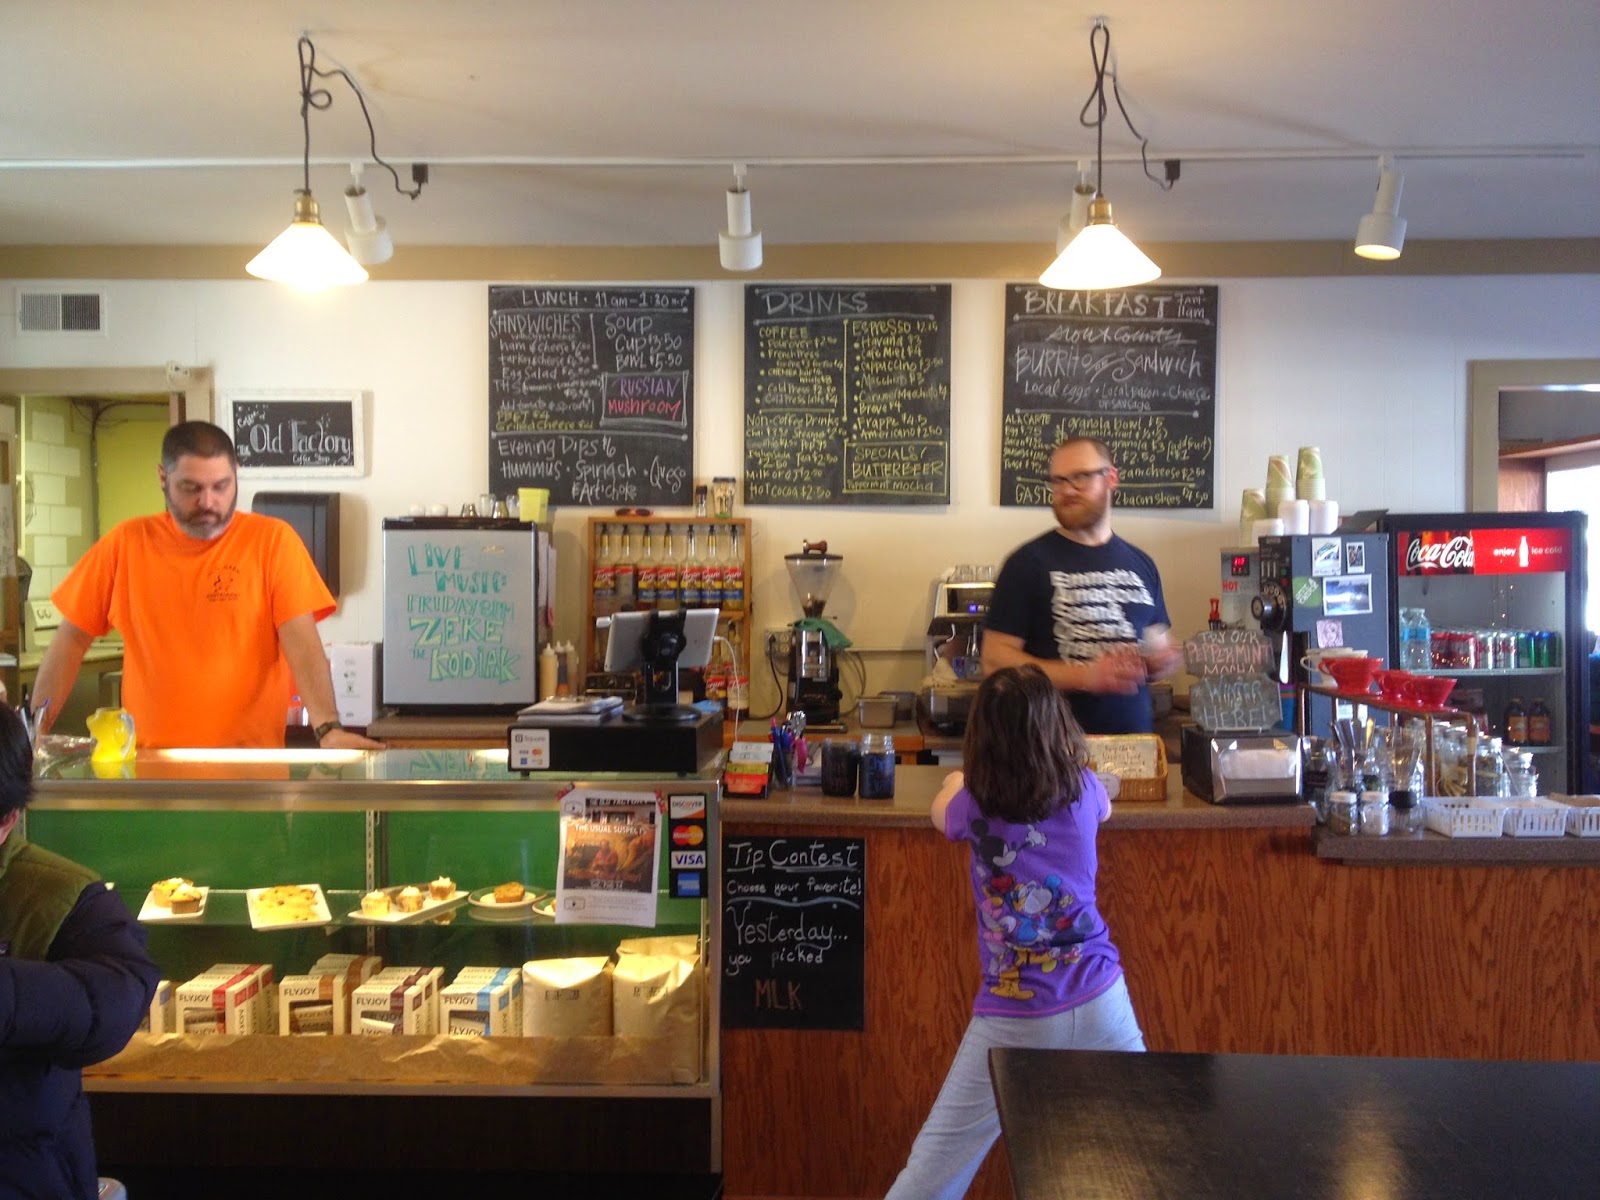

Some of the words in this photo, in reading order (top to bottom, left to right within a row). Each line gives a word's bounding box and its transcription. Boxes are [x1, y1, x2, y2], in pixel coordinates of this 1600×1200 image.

[522, 290, 579, 308] LUNCH
[762, 291, 869, 316] DRINKS
[1024, 289, 1173, 319] BREAKFAST
[490, 312, 581, 339] SANDWICHES
[605, 312, 653, 340] SOUP
[759, 326, 808, 340] COFFEE
[499, 339, 526, 351] ham
[861, 335, 904, 349] Havana
[524, 365, 558, 380] Salad
[1112, 348, 1202, 384] Sandwich
[619, 377, 681, 399] RUSSIAN
[1025, 379, 1061, 397] Local
[1101, 382, 1129, 398] Local
[1068, 417, 1111, 434] granola
[1114, 416, 1142, 431] bowl
[249, 422, 285, 455] Old
[288, 417, 352, 464] Factory
[498, 438, 556, 461] Evening
[1111, 439, 1148, 456] granola
[575, 453, 637, 481] Spinach
[852, 460, 944, 480] BUTTERBEER
[579, 478, 637, 506] Artichoke
[1406, 536, 1475, 572] Coca-Cola
[1492, 547, 1517, 558] enjoy
[1531, 545, 1543, 556] ice
[1544, 545, 1564, 556] cold
[1222, 580, 1239, 592] HOT
[407, 593, 480, 616] FRIDAY
[409, 616, 507, 648] ZEKE
[1230, 630, 1260, 645] OUR
[429, 646, 521, 684] KODIAK
[672, 800, 704, 809] DISCOVER
[575, 823, 588, 832] THE
[590, 825, 611, 834] USUAL
[613, 825, 648, 836] SUSPECTS
[675, 853, 704, 866] VISA
[728, 842, 764, 875] Tip
[769, 840, 860, 867] Contest
[727, 880, 767, 895] Choose
[774, 883, 799, 896] your
[726, 954, 752, 976] you
[771, 945, 824, 969] picked
[179, 994, 211, 1003] FLYJOY
[284, 988, 316, 997] FLYJOY
[356, 997, 388, 1006] FLYJOY
[444, 997, 475, 1006] FLYJOY
[755, 978, 802, 1011] MLK
